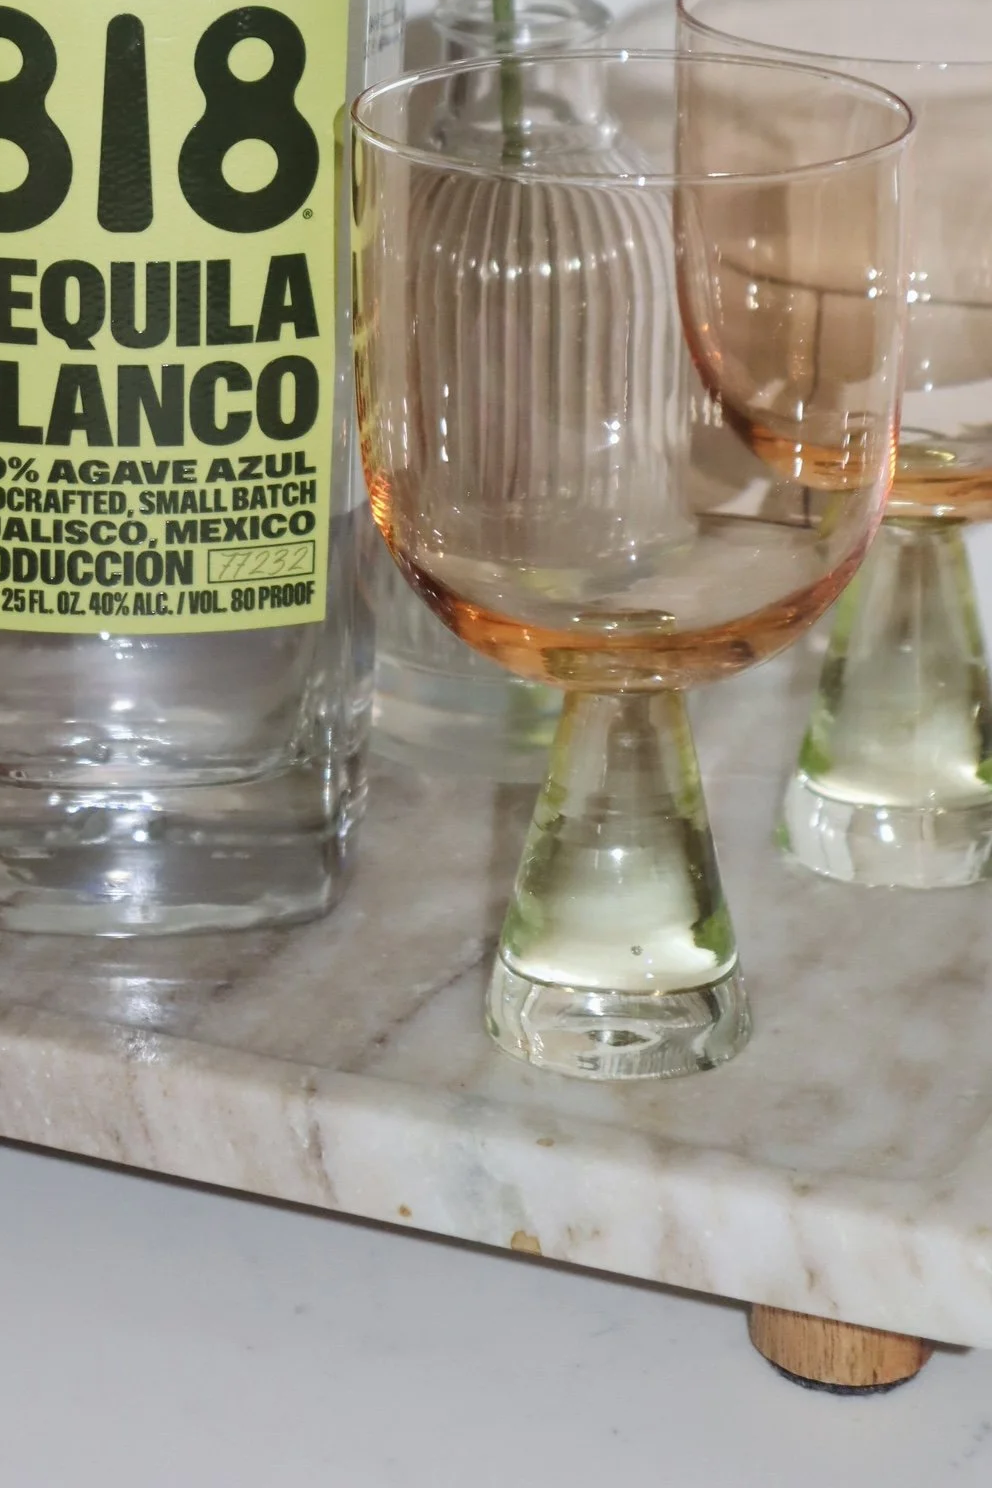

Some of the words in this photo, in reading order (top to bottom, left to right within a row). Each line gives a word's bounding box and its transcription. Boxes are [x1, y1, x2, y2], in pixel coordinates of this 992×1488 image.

[47, 459, 198, 485] AGAVE
[205, 450, 317, 484] AZUL
[138, 487, 228, 516] SMALL
[232, 478, 317, 511] BATCH
[165, 510, 316, 544] MEXICO
[1, 587, 26, 612] 25
[29, 589, 54, 615] FL.
[57, 591, 86, 616] OZ.
[89, 591, 129, 617] 40%
[230, 587, 256, 612] 80
[258, 581, 315, 610] PROOF
